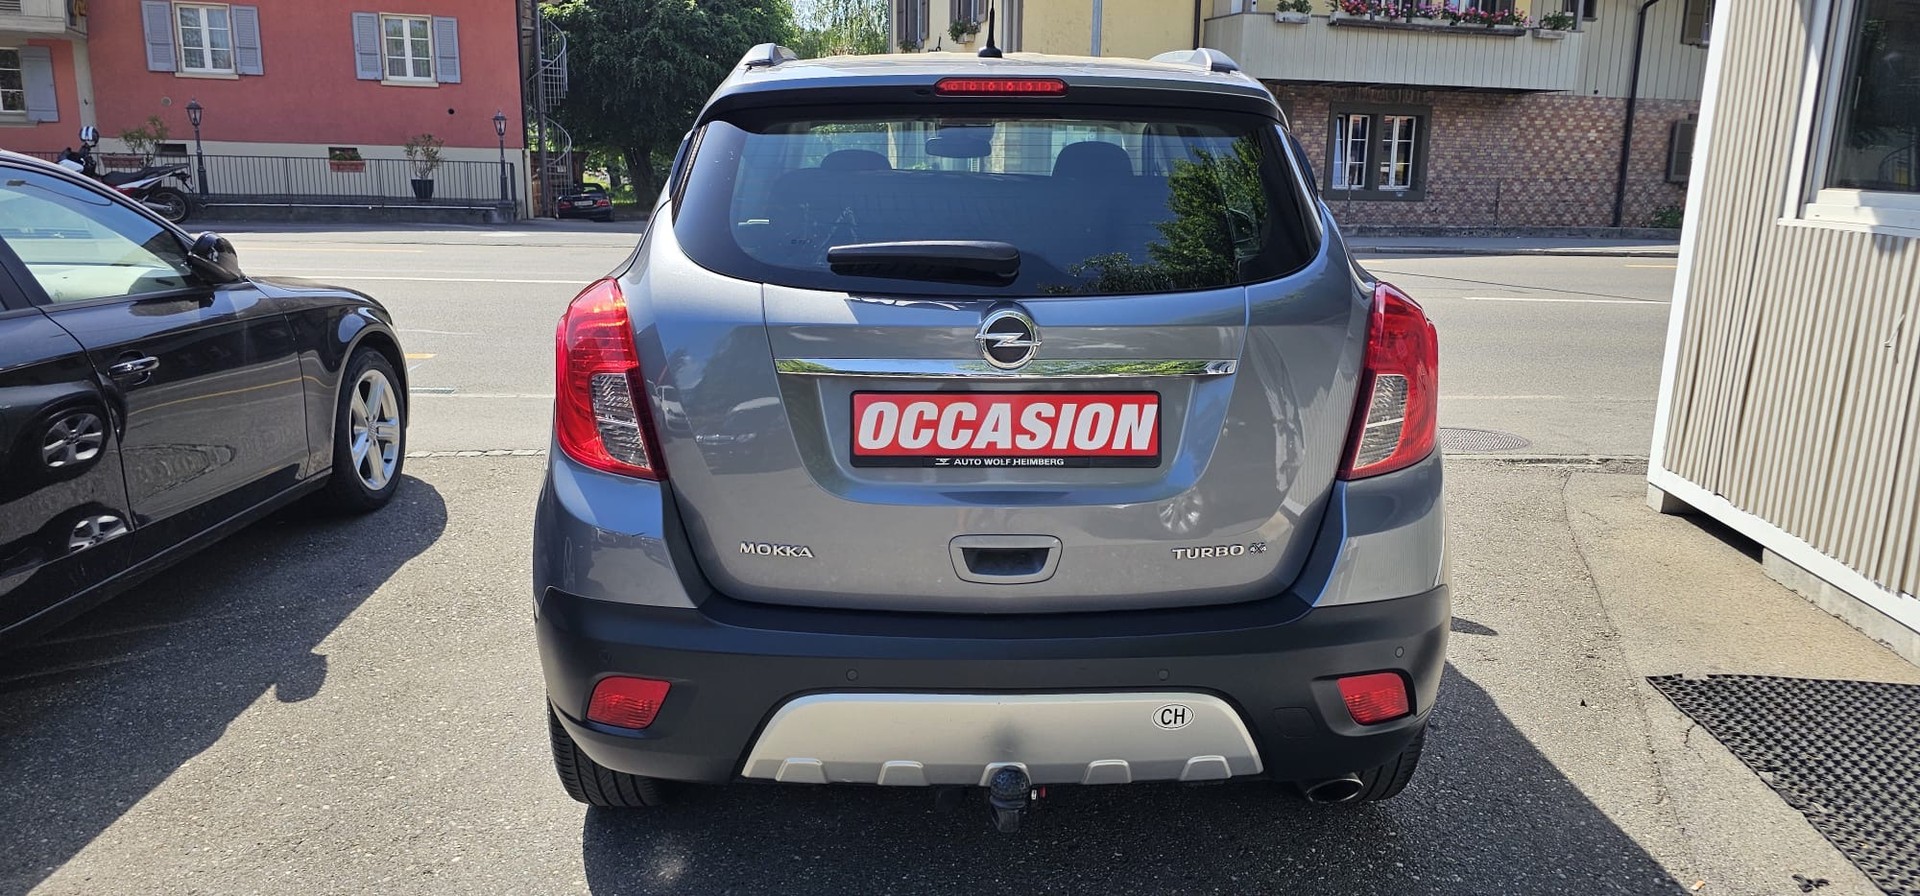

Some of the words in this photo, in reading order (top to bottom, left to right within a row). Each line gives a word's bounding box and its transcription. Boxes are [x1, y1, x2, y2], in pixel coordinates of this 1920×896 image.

[857, 401, 1158, 450] OCCASION
[953, 458, 981, 466] AUTO
[1013, 458, 1064, 466] HEIMBERG
[739, 541, 815, 558] MOKKA
[1171, 544, 1245, 560] TURBO
[1161, 708, 1185, 725] CH
